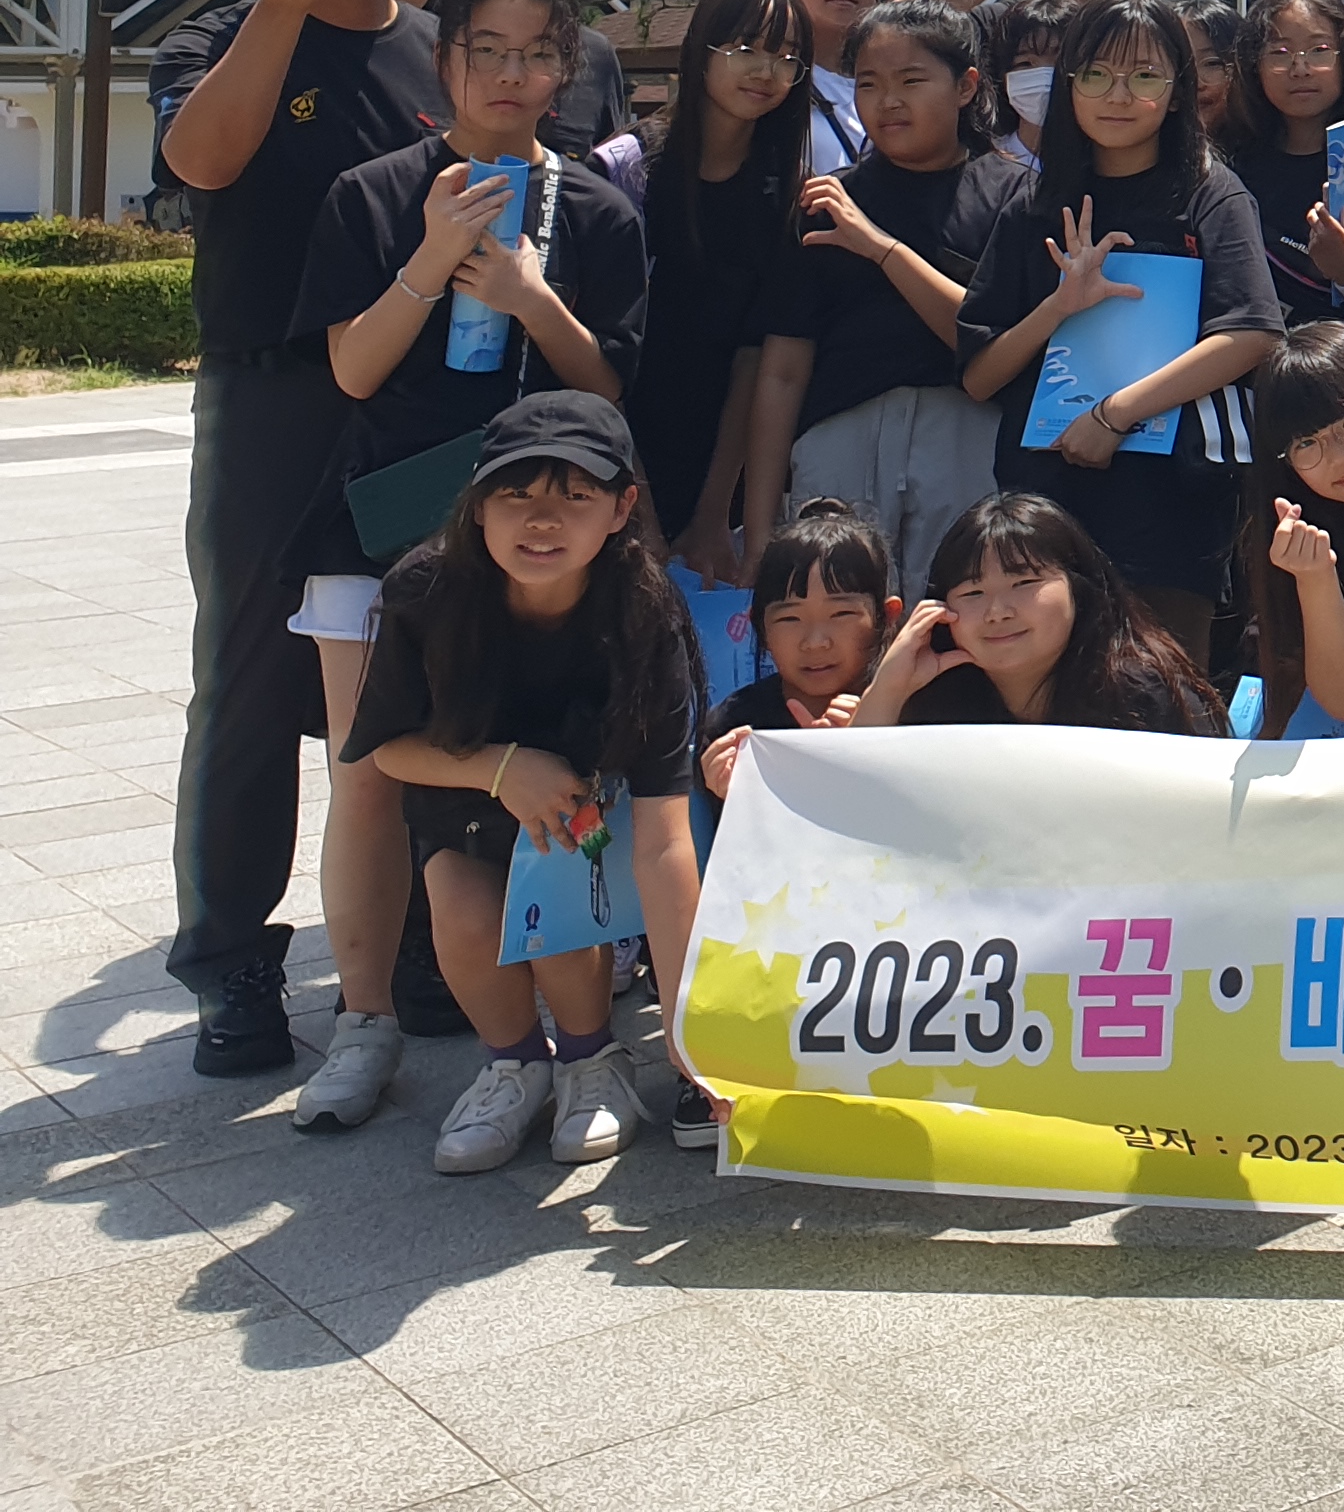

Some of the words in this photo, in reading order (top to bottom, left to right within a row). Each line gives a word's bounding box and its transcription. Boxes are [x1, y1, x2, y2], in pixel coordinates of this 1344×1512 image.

[799, 938, 1043, 1054] 2023.
[1078, 918, 1173, 1058] 꿈
[1114, 1124, 1196, 1156] 일자
